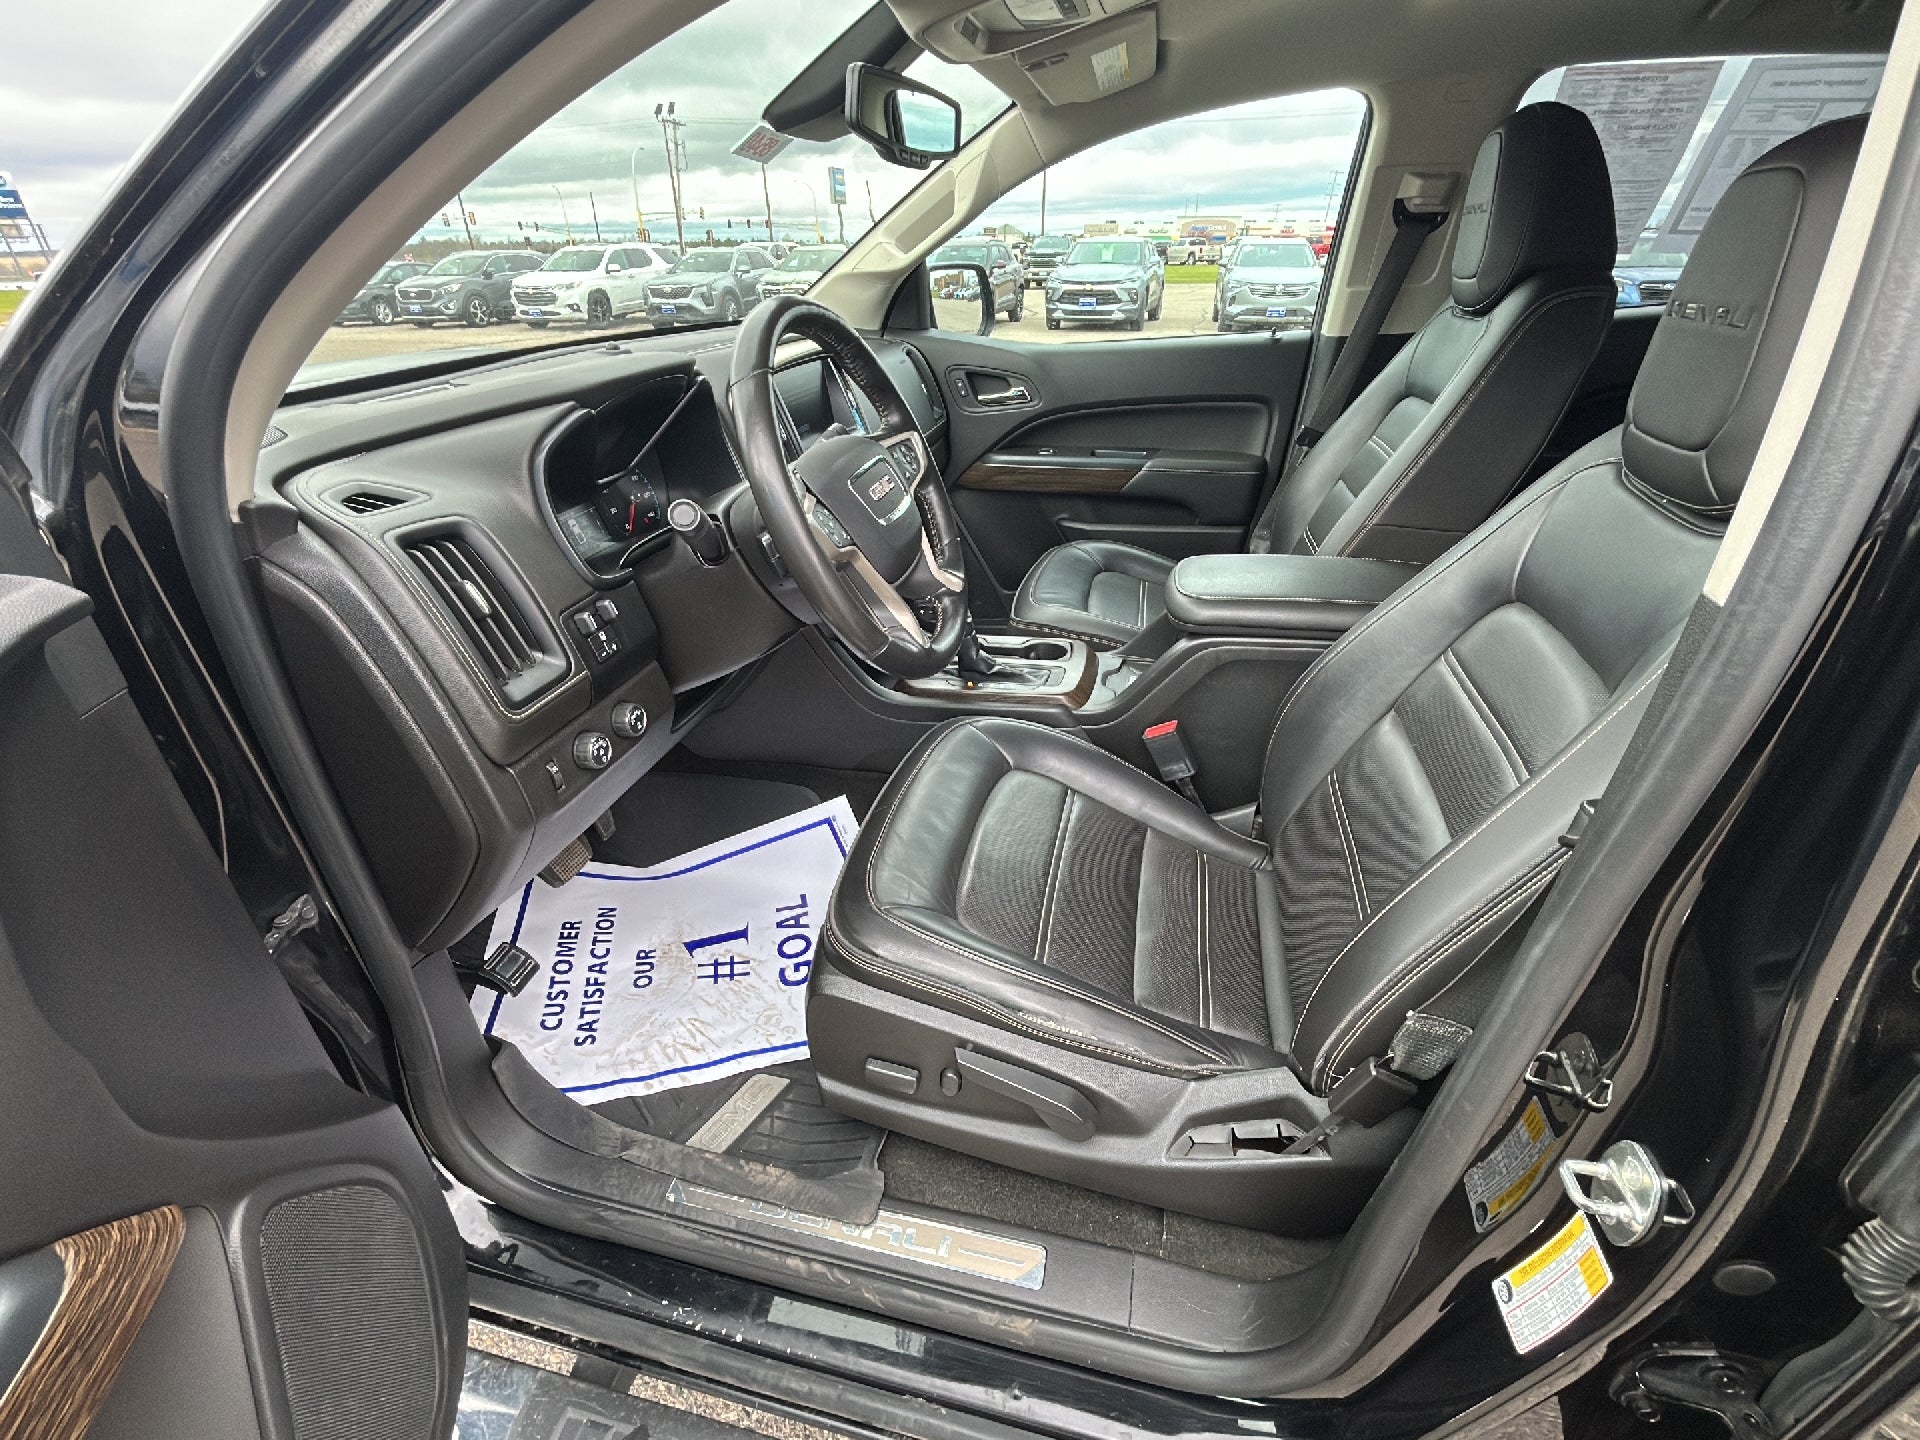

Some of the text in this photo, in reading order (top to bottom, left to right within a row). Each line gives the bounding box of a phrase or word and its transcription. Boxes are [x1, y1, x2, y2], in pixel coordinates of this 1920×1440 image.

[540, 919, 583, 1032] CUSTOMER
[573, 906, 617, 1047] SATISFACTION
[632, 948, 656, 989] OUR
[682, 921, 751, 985] #1
[774, 892, 813, 987] GOAL
